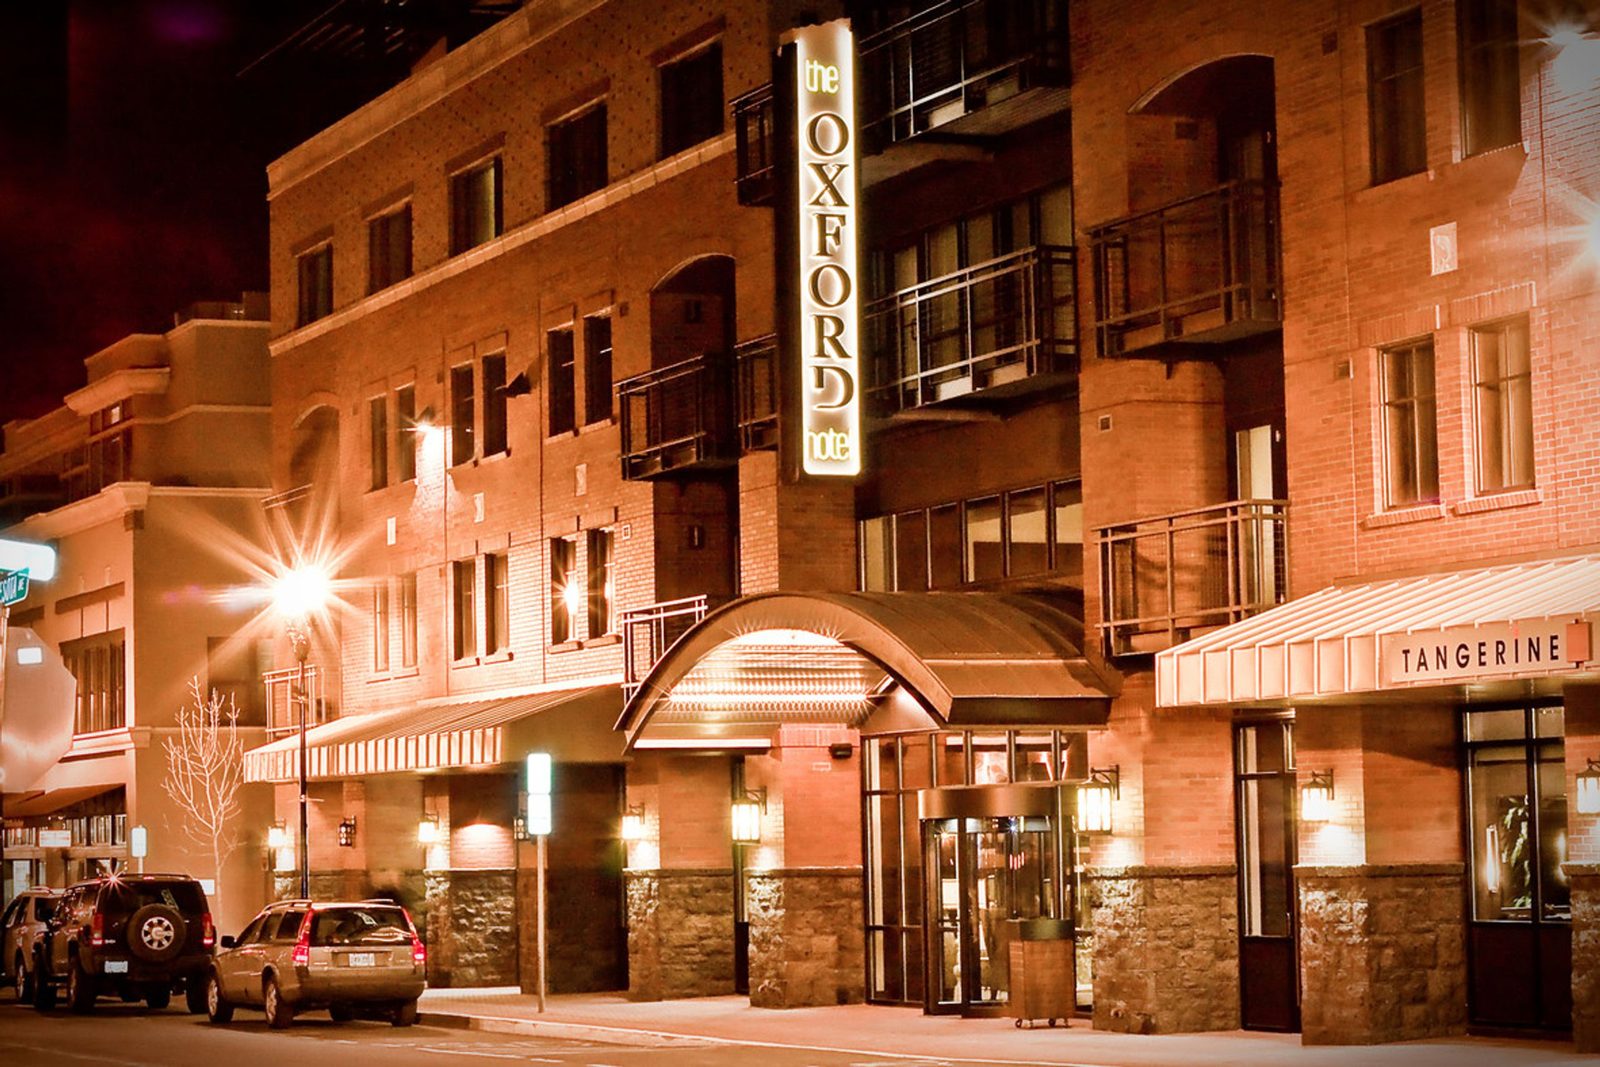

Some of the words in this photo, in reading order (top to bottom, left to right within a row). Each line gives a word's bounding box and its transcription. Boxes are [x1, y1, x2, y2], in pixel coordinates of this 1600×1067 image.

[805, 59, 839, 94] the
[806, 112, 854, 409] OXFORD
[804, 426, 852, 461] hote
[1402, 634, 1559, 674] TANGERINE
